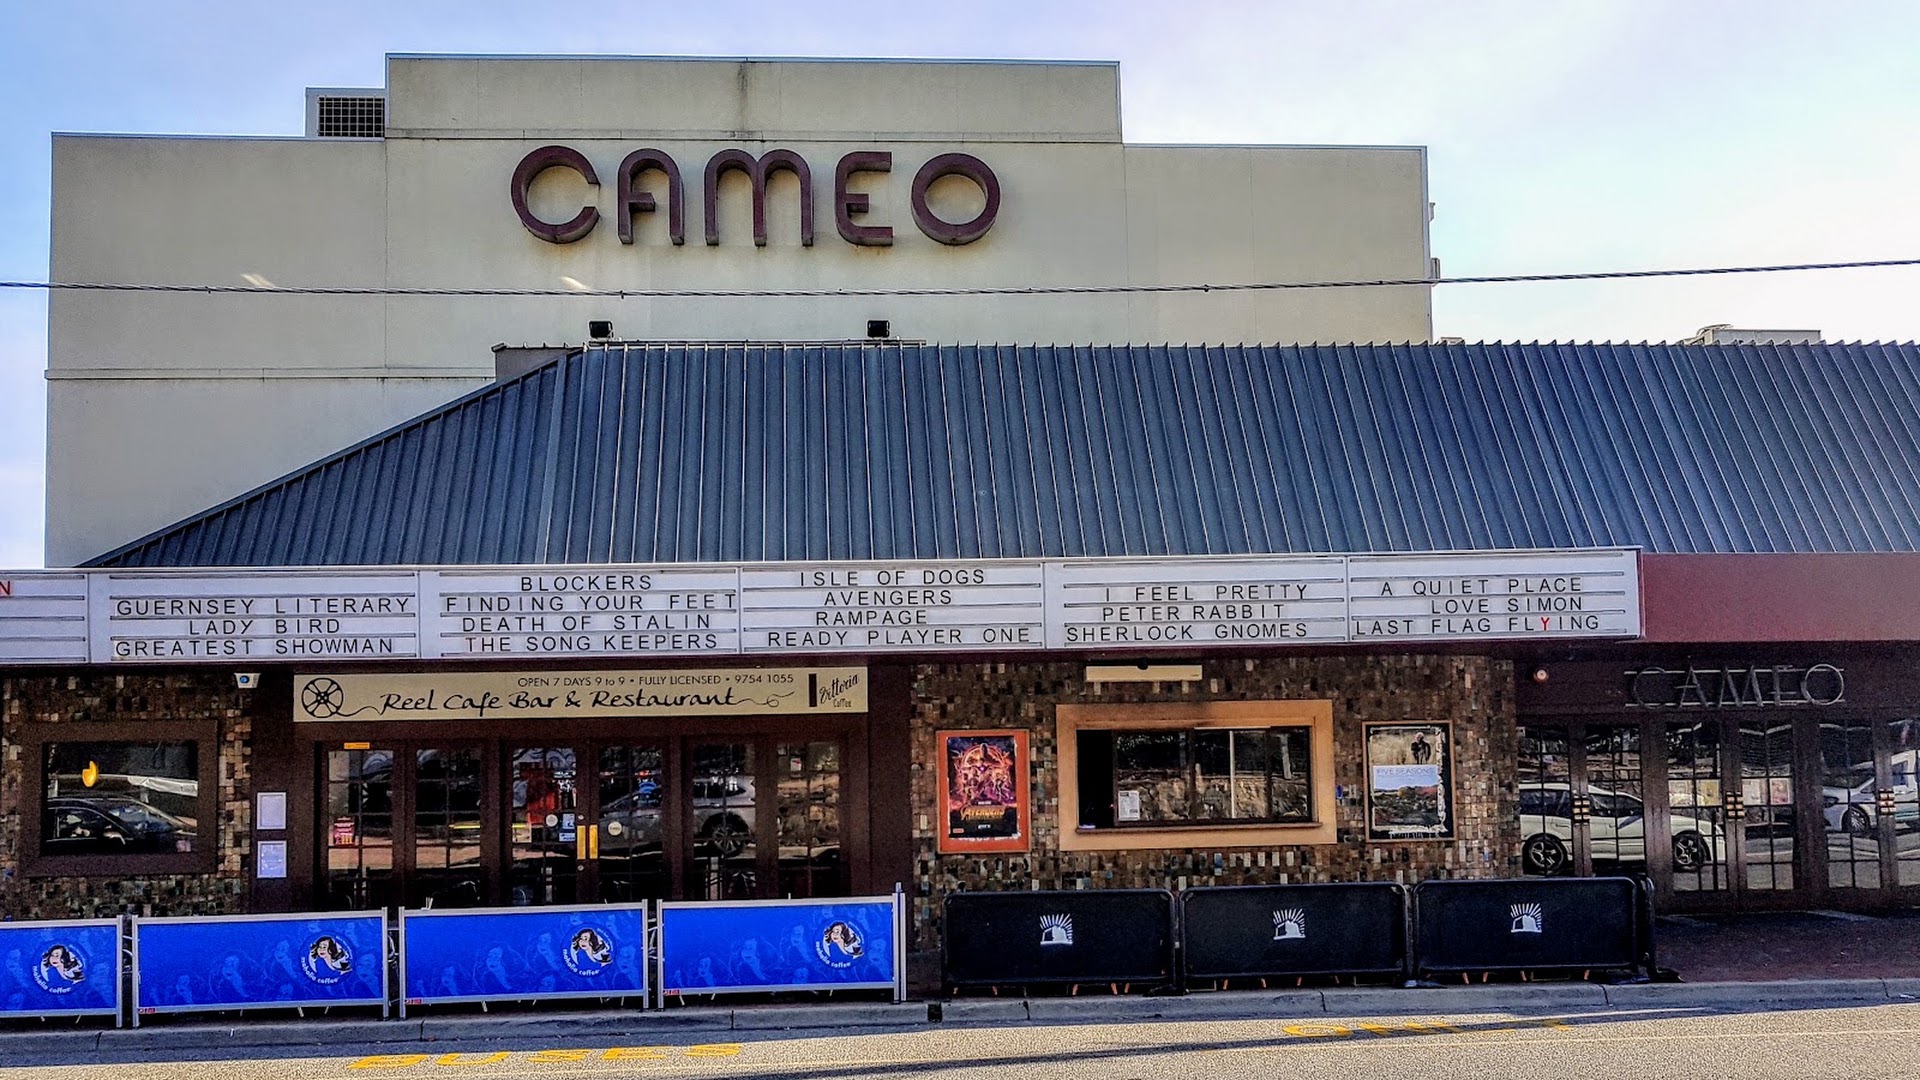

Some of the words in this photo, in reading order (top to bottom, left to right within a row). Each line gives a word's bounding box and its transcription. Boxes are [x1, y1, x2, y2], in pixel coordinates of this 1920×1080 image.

[511, 145, 1001, 246] CAMEO
[522, 575, 652, 591] BLOCKERS
[800, 571, 858, 586] ISLE
[877, 571, 906, 585] OF
[923, 569, 984, 584] DOGS
[1106, 588, 1110, 601] I
[1136, 586, 1194, 601] FEEL
[1216, 584, 1307, 599] PRETTY
[1381, 582, 1392, 595] A
[1413, 580, 1488, 596] QUIET
[1508, 578, 1581, 593] PLACE
[446, 596, 564, 612] FINDING
[580, 595, 643, 610] YOUR
[670, 594, 736, 609] FEET
[824, 590, 952, 605] AVENGERS
[1432, 599, 1489, 614] LOVE
[1508, 597, 1582, 612] SIMON
[117, 599, 254, 615] GUERNSEY
[276, 598, 409, 613] LITERARY
[1103, 606, 1180, 621] PETER
[1193, 605, 1284, 619] RABBIT
[462, 617, 544, 632] DEATH
[562, 616, 592, 630] OF
[614, 614, 710, 629] STALIN
[816, 610, 927, 625] RAMPAGE
[1356, 620, 1413, 635] LAST
[1432, 618, 1491, 633] FLAG
[1509, 615, 1599, 631] FLYING
[190, 620, 254, 634] LADY
[276, 619, 340, 633] BIRD
[1067, 625, 1193, 642] SHERLOCK
[1215, 623, 1307, 638] GNOMES
[466, 637, 511, 652] THE
[526, 636, 590, 651] SONG
[604, 634, 717, 650] KEEPERS
[768, 631, 848, 646] READY
[868, 630, 962, 645] PLAYER
[983, 628, 1029, 643] ONE
[115, 641, 253, 656] GREATEST
[276, 639, 392, 654] SHOWMAN
[518, 678, 549, 686] OPEN
[553, 678, 560, 686] 7
[564, 676, 591, 686] DAYS
[595, 677, 602, 686] 9
[605, 677, 614, 686] to
[618, 677, 625, 685] 9
[639, 676, 667, 685] FULLY
[670, 675, 721, 684] LICENSED
[735, 675, 762, 683] 9754
[767, 674, 793, 683] 1055
[1634, 664, 1844, 708] CAMEO
[380, 690, 437, 716] Reel
[508, 691, 559, 708] Bar
[565, 691, 581, 707] &
[589, 687, 735, 708] Restaurant
